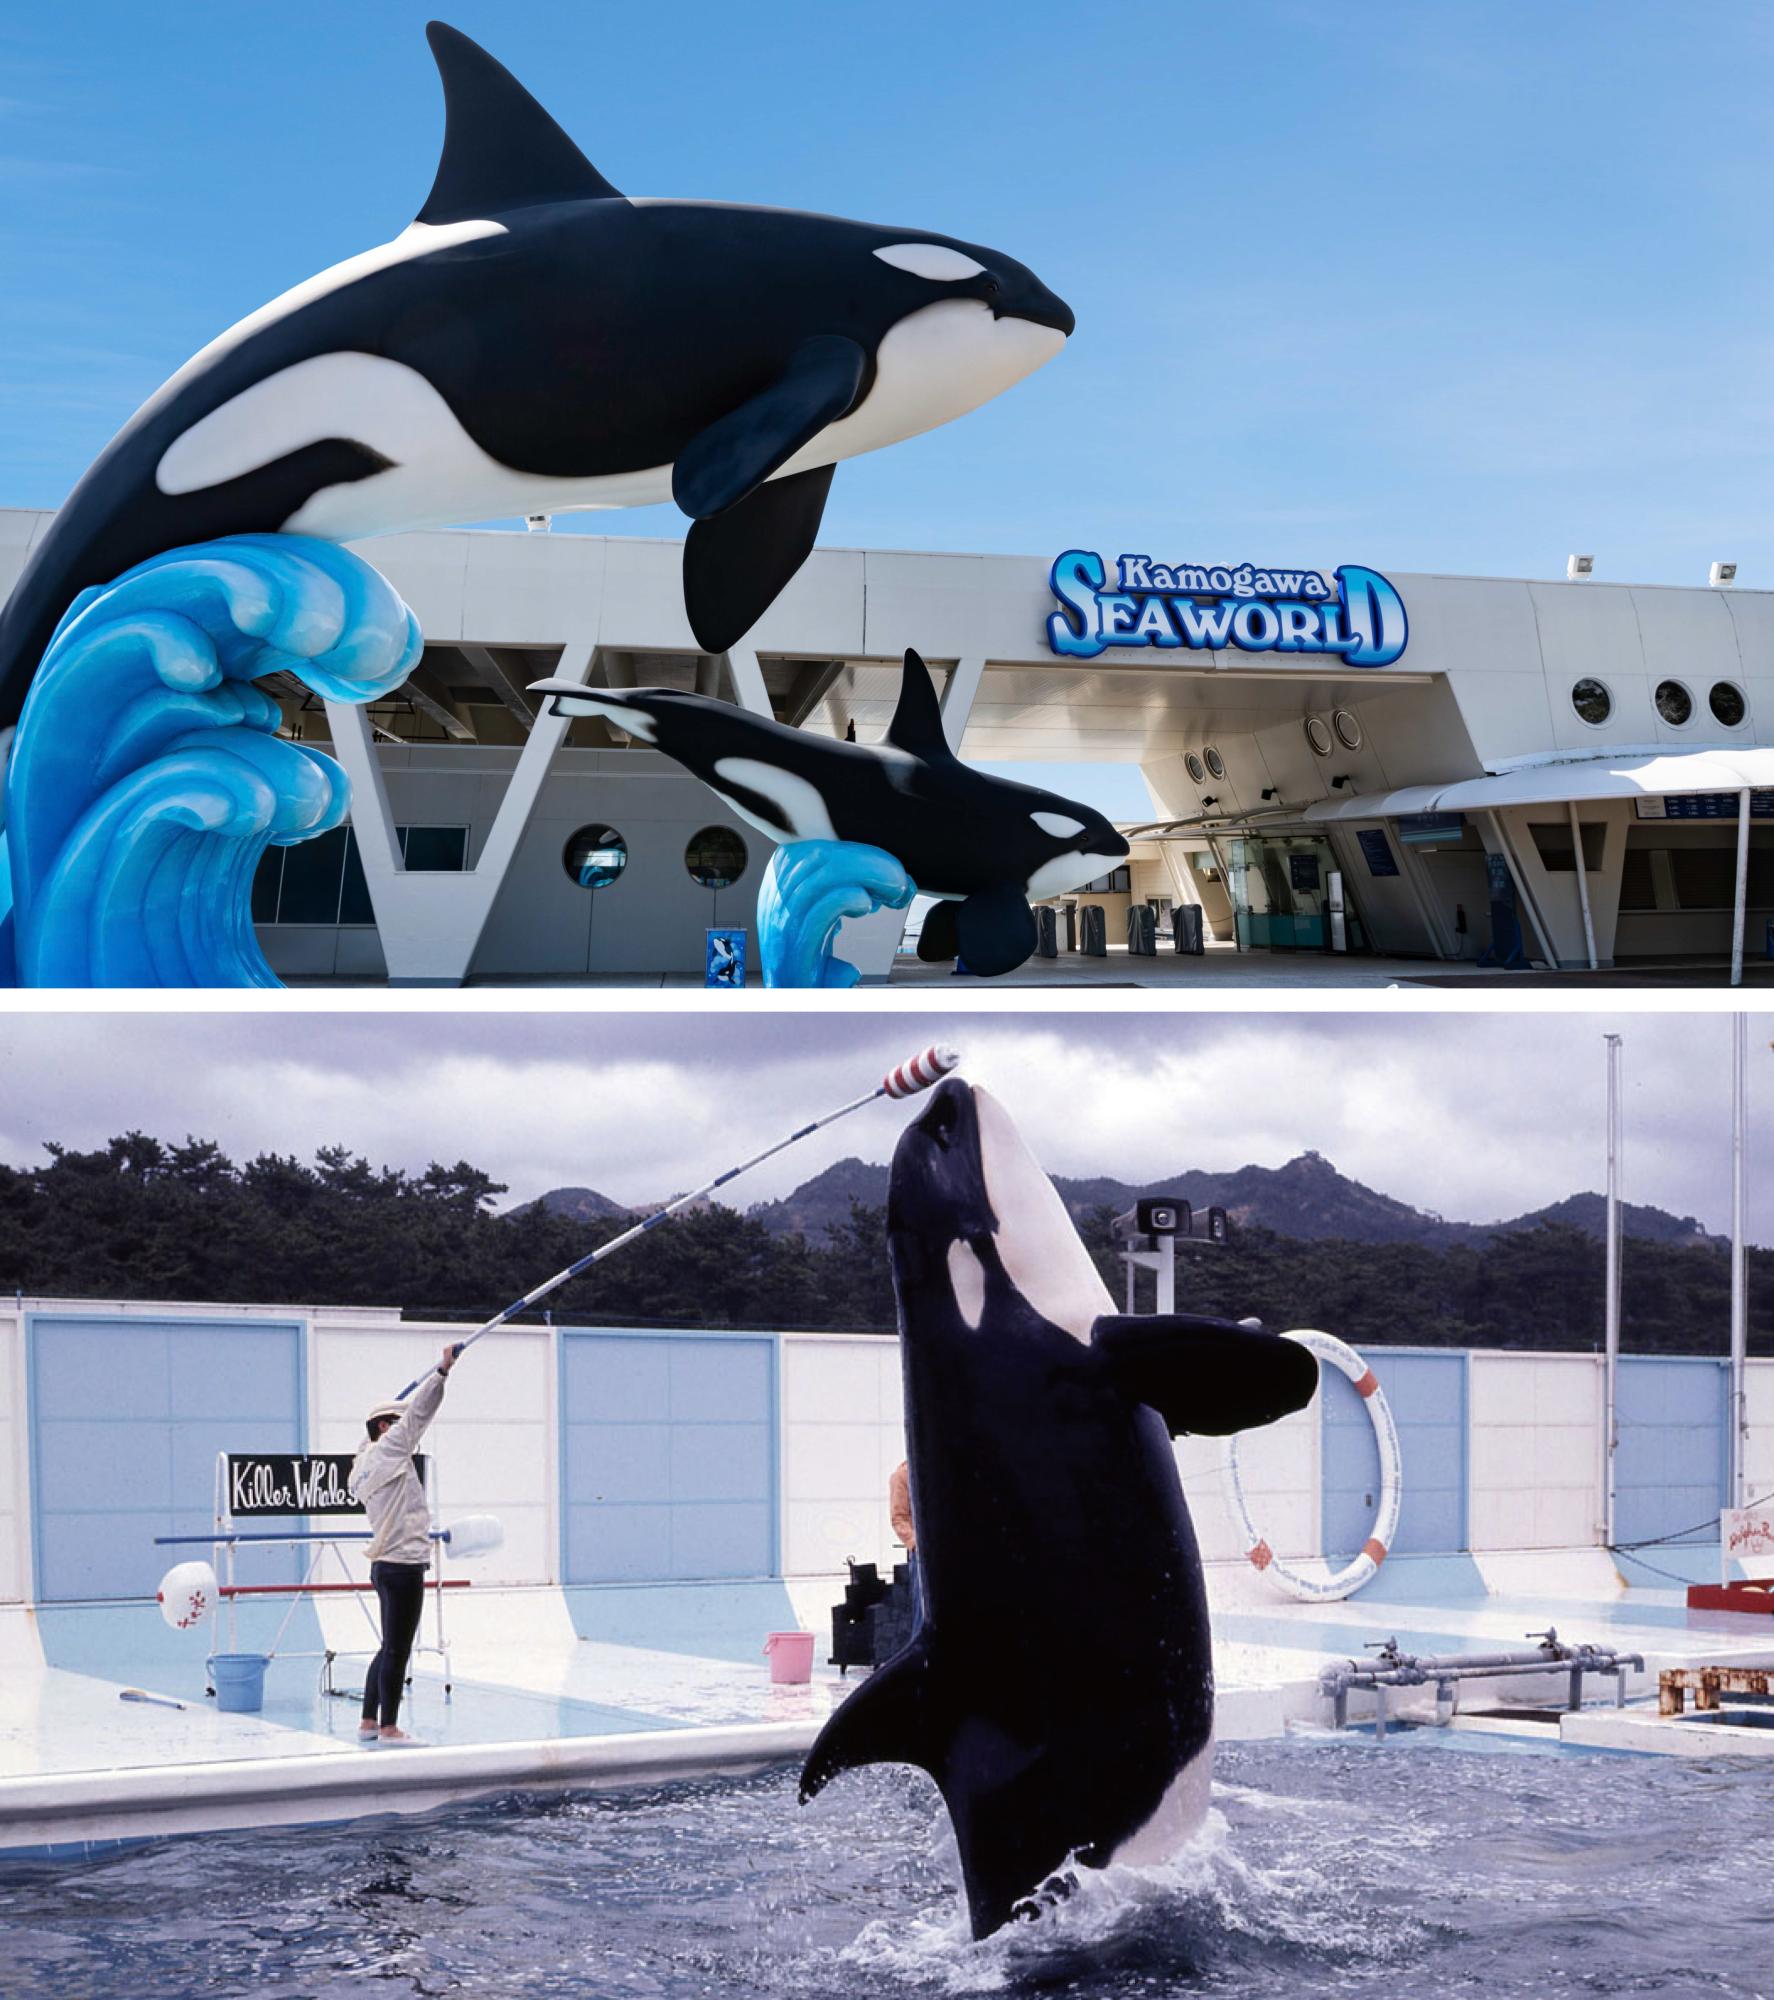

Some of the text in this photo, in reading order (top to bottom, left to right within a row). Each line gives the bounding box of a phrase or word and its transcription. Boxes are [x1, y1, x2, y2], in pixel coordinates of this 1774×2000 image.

[1119, 555, 1328, 599] Kamogawa
[1048, 550, 1407, 667] SEAWORLD
[231, 1461, 295, 1509] Killer
